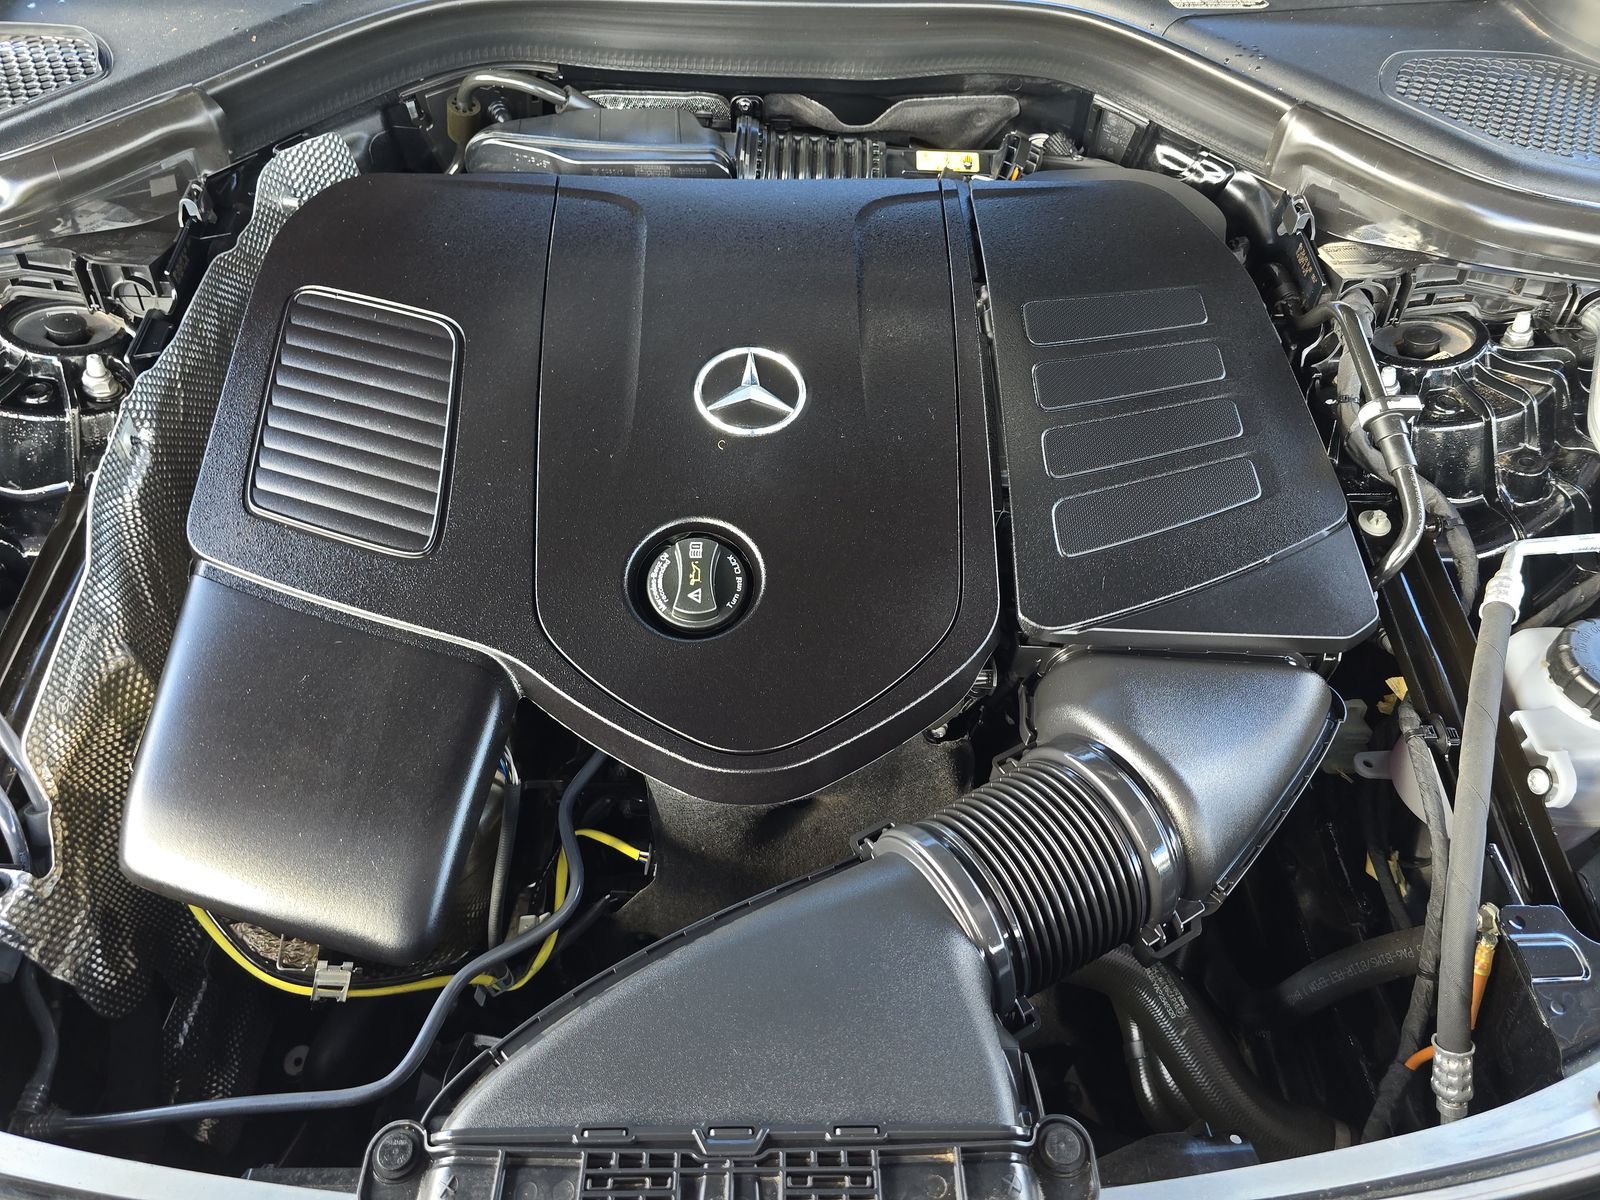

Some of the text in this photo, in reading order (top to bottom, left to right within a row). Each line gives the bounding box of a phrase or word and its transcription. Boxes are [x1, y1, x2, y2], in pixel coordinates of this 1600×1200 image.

[650, 561, 667, 613] Mercedes-Benz
[726, 554, 743, 609] Turn until CLICK
